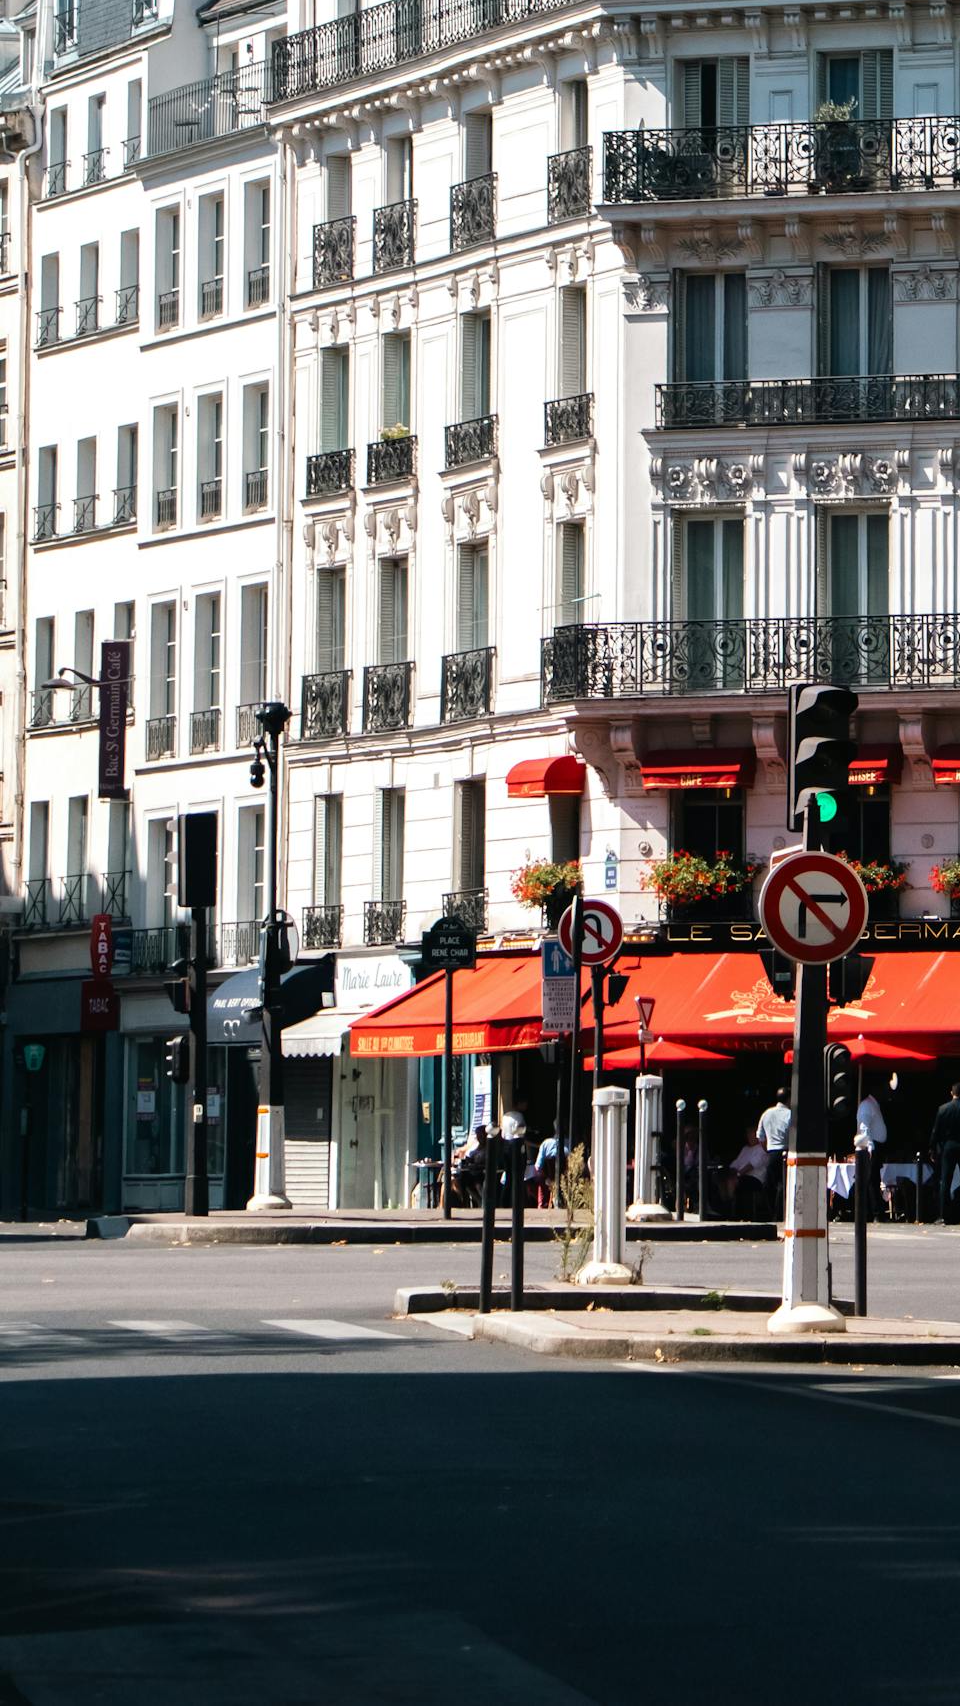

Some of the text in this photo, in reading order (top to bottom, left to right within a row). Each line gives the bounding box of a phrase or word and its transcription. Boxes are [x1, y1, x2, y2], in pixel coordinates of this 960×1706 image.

[107, 651, 121, 680] Café
[106, 683, 120, 738] Germain
[680, 774, 702, 786] CAFE
[848, 770, 876, 781] ATISEE
[439, 936, 460, 945] PLACE
[666, 925, 713, 942] LE
[97, 922, 109, 974] TABAC
[431, 947, 469, 957] RENÉ CHAR
[342, 962, 402, 991] Marie Laure
